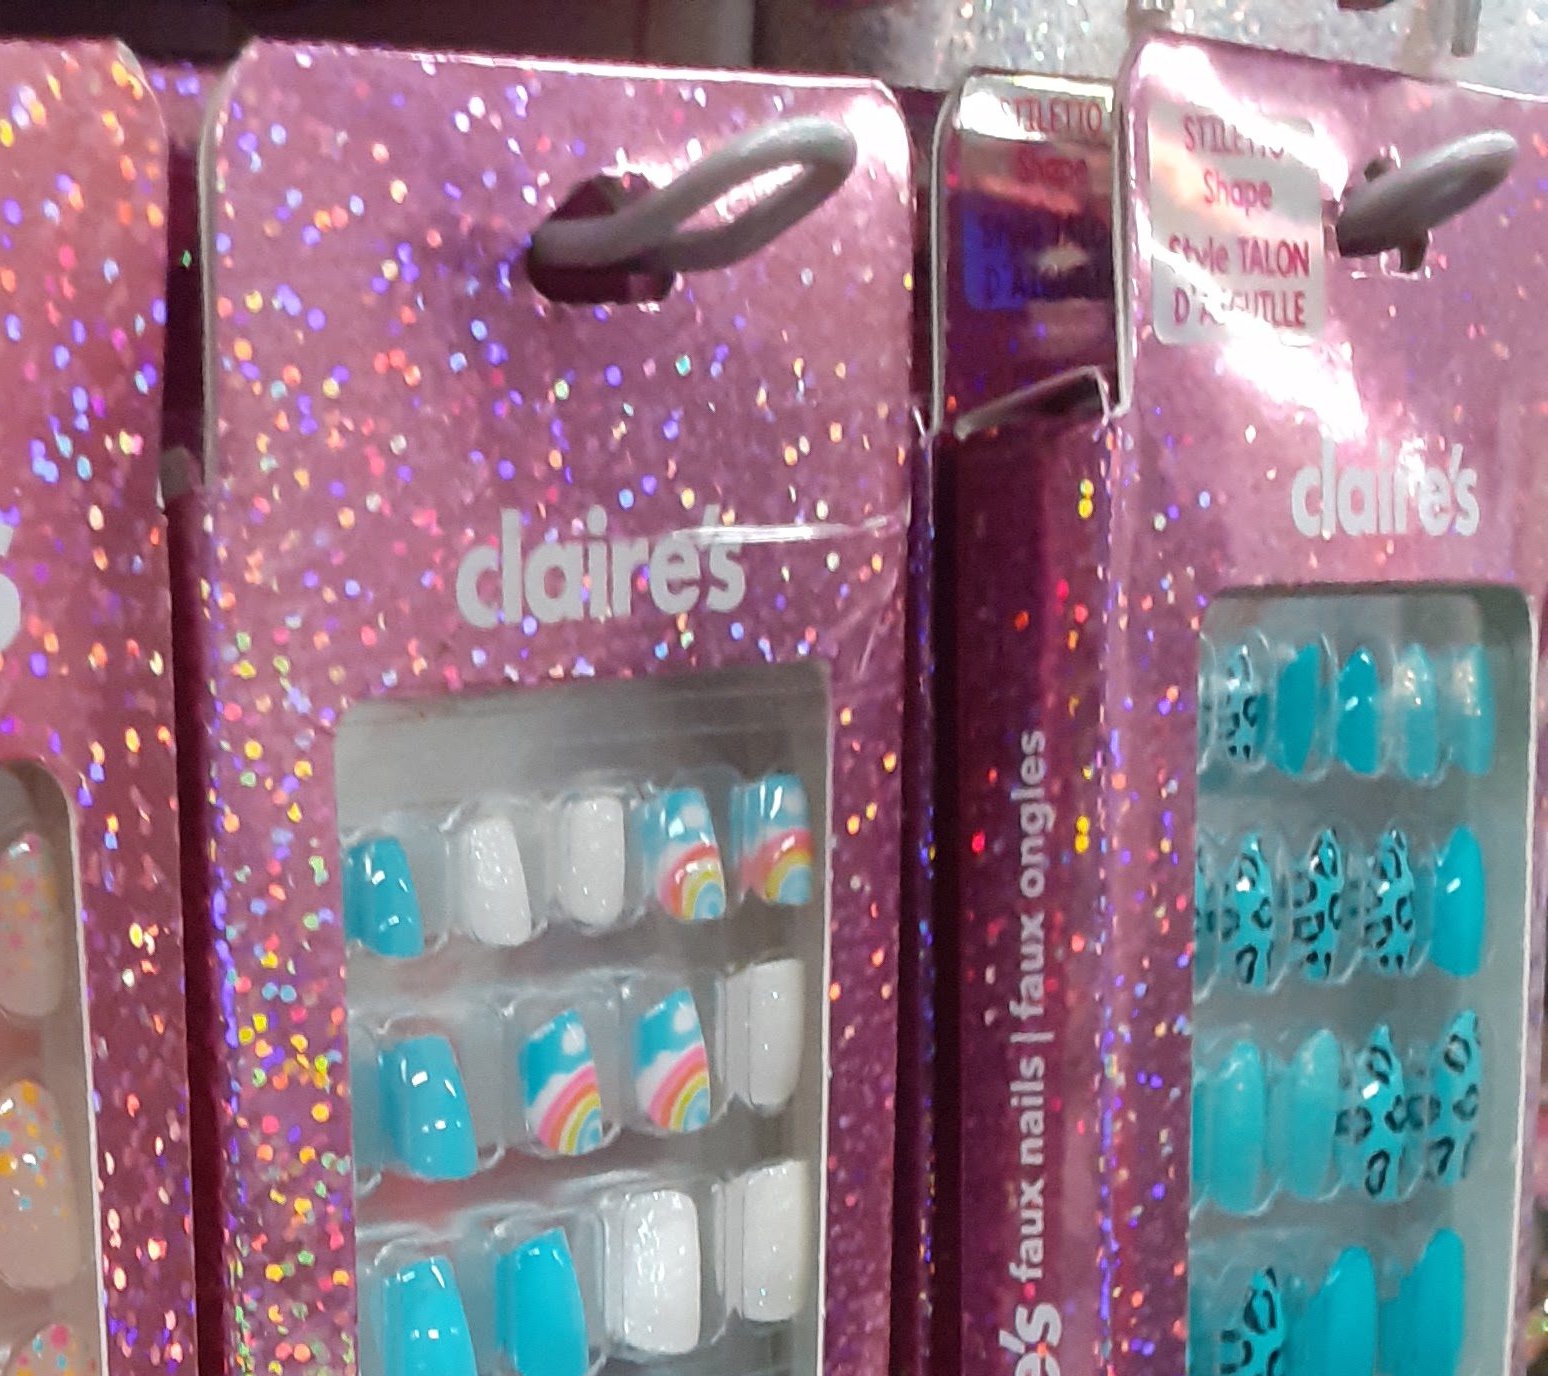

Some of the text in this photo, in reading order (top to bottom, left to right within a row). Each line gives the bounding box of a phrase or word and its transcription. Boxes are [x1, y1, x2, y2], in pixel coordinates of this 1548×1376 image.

[1204, 169, 1274, 216] Shape
[1237, 236, 1310, 278] TALON
[1291, 436, 1481, 537] claire's
[455, 503, 746, 629] claire's
[1009, 730, 1057, 898] ongles
[1009, 911, 1045, 1020] faux
[1009, 1054, 1045, 1167] nails
[1009, 1176, 1045, 1283] faux
